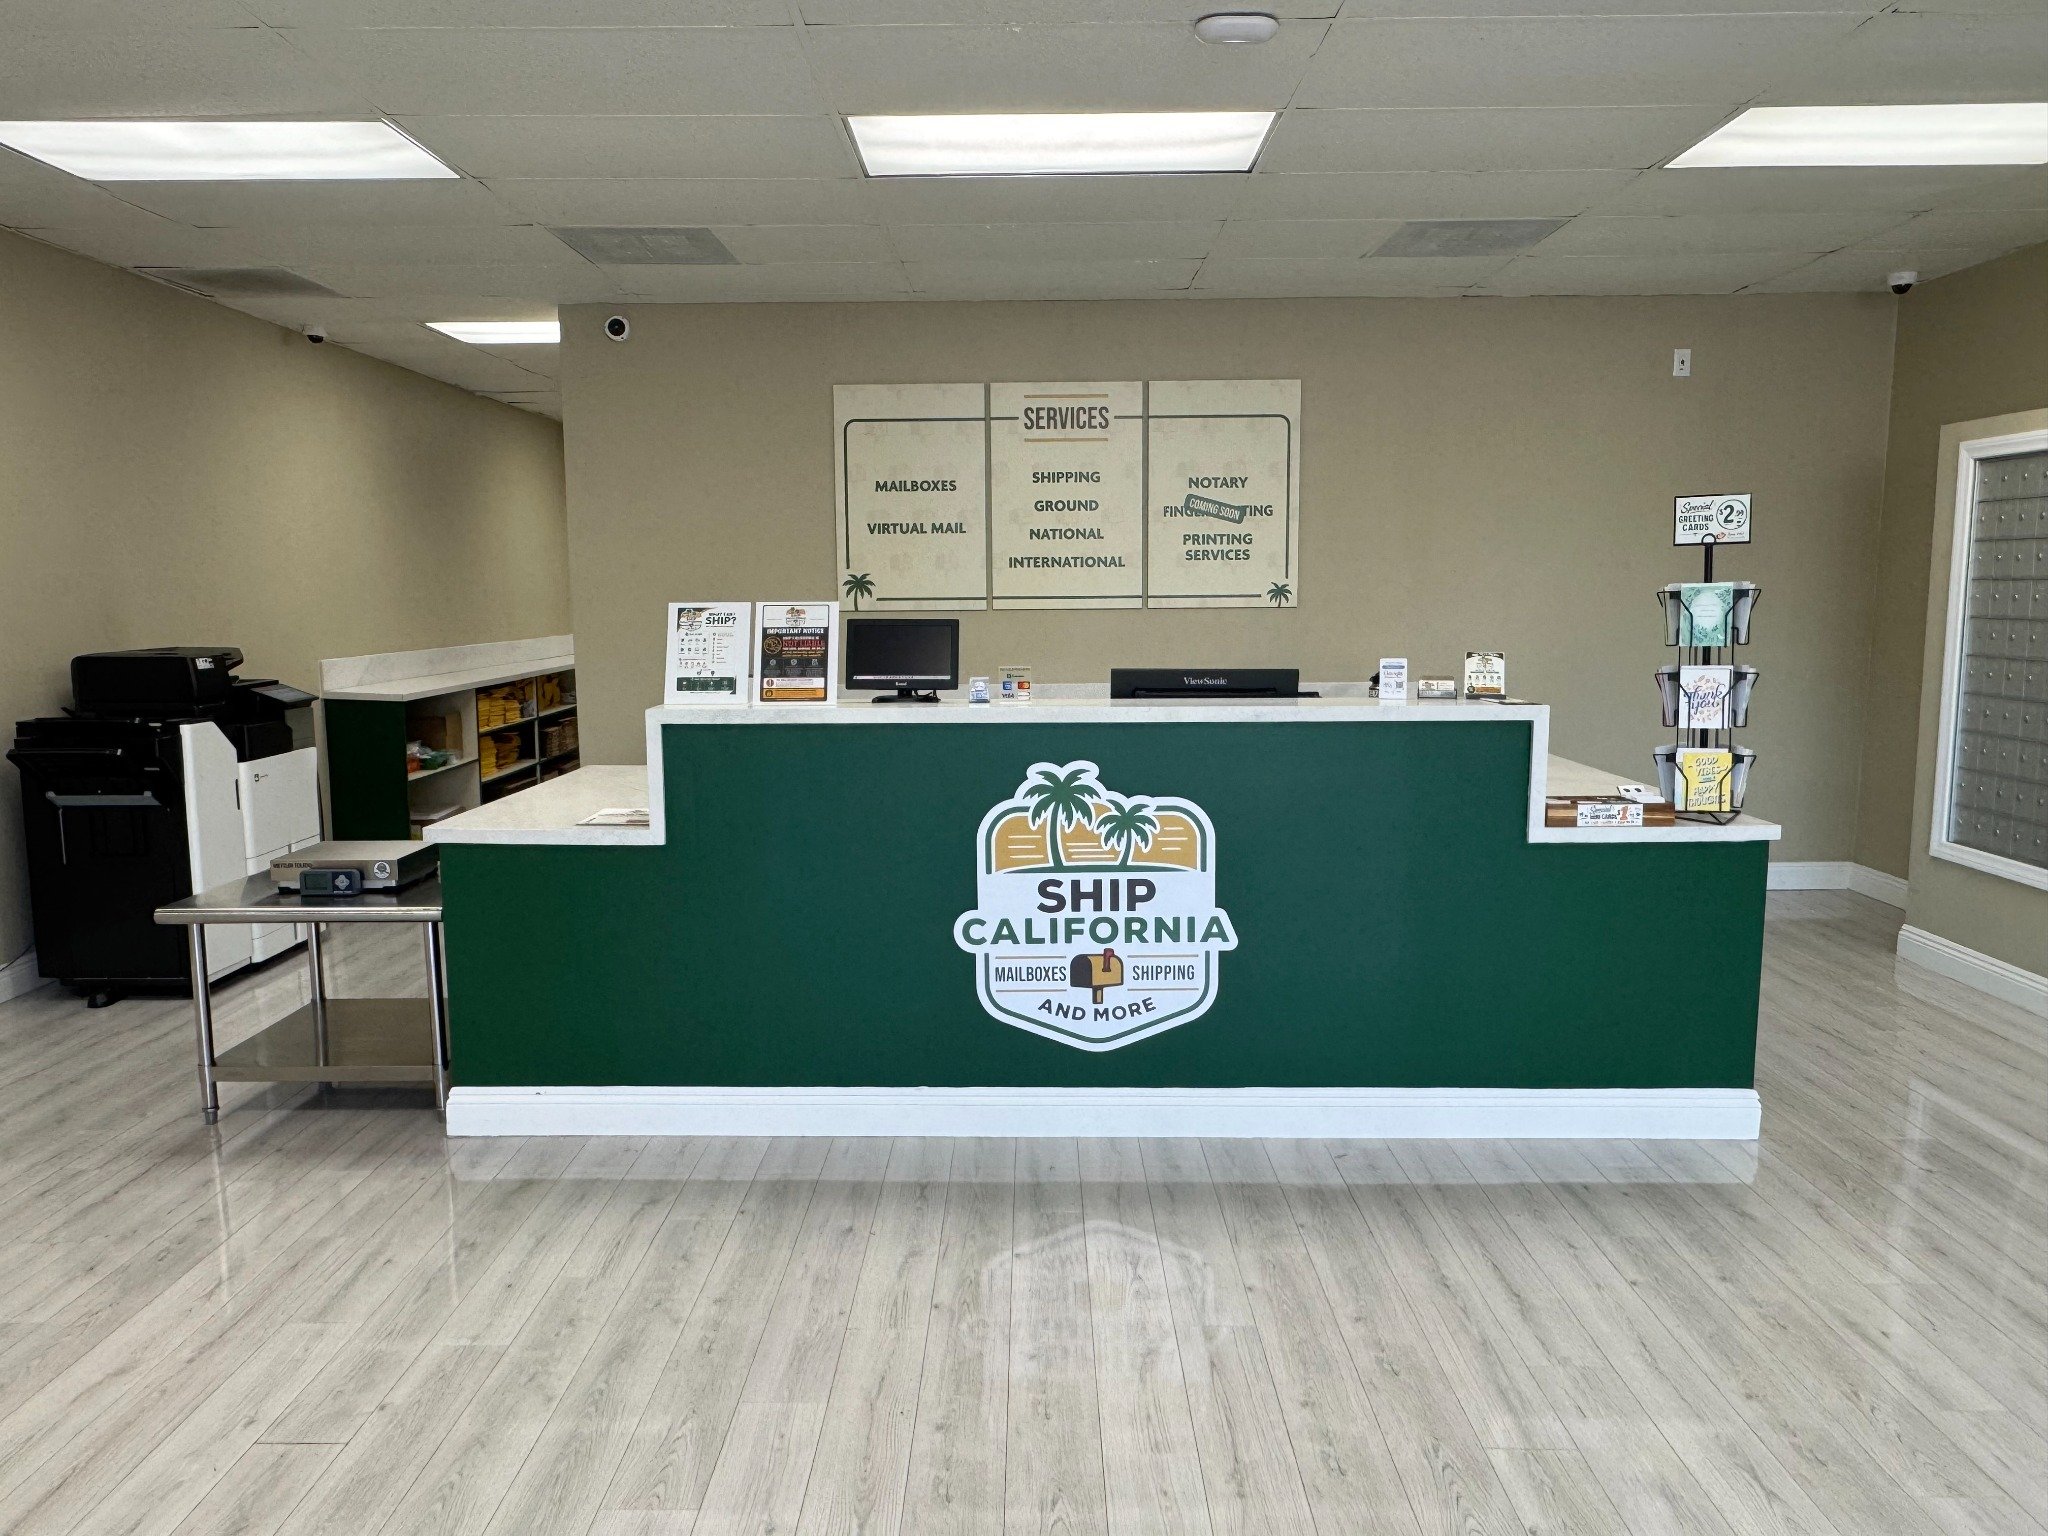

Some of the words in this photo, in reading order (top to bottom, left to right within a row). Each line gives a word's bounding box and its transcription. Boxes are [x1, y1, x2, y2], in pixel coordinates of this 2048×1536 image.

[1023, 406, 1110, 431] SERVICES
[1031, 471, 1101, 485] SHIPPING
[1188, 476, 1249, 489] NOTARY
[874, 479, 957, 493] MAILBOXES
[1034, 499, 1099, 513] GROUND
[1189, 498, 1219, 515] COMING
[1219, 506, 1241, 520] SOON
[1680, 499, 1715, 515] Special
[1678, 514, 1714, 524] GREETING
[867, 522, 928, 535] VIRTUAL
[931, 521, 967, 534] MAIL
[1029, 527, 1105, 541] NATIONAL
[1682, 523, 1709, 532] CARDS
[1183, 533, 1253, 546] PRINTING
[1185, 549, 1251, 561] SERVICES
[1008, 555, 1126, 570] INTERNATIONAL
[705, 616, 737, 625] SHIP?
[1184, 677, 1228, 685] ViewSonic
[1696, 757, 1719, 767] GOOD
[1037, 878, 1157, 914] SHIP
[961, 915, 1231, 946] CALIFORNIA
[995, 966, 1067, 982] MAILBOXES
[1132, 965, 1196, 981] SHIPPING
[1038, 998, 1087, 1022] AND
[1093, 996, 1158, 1022] MORE
